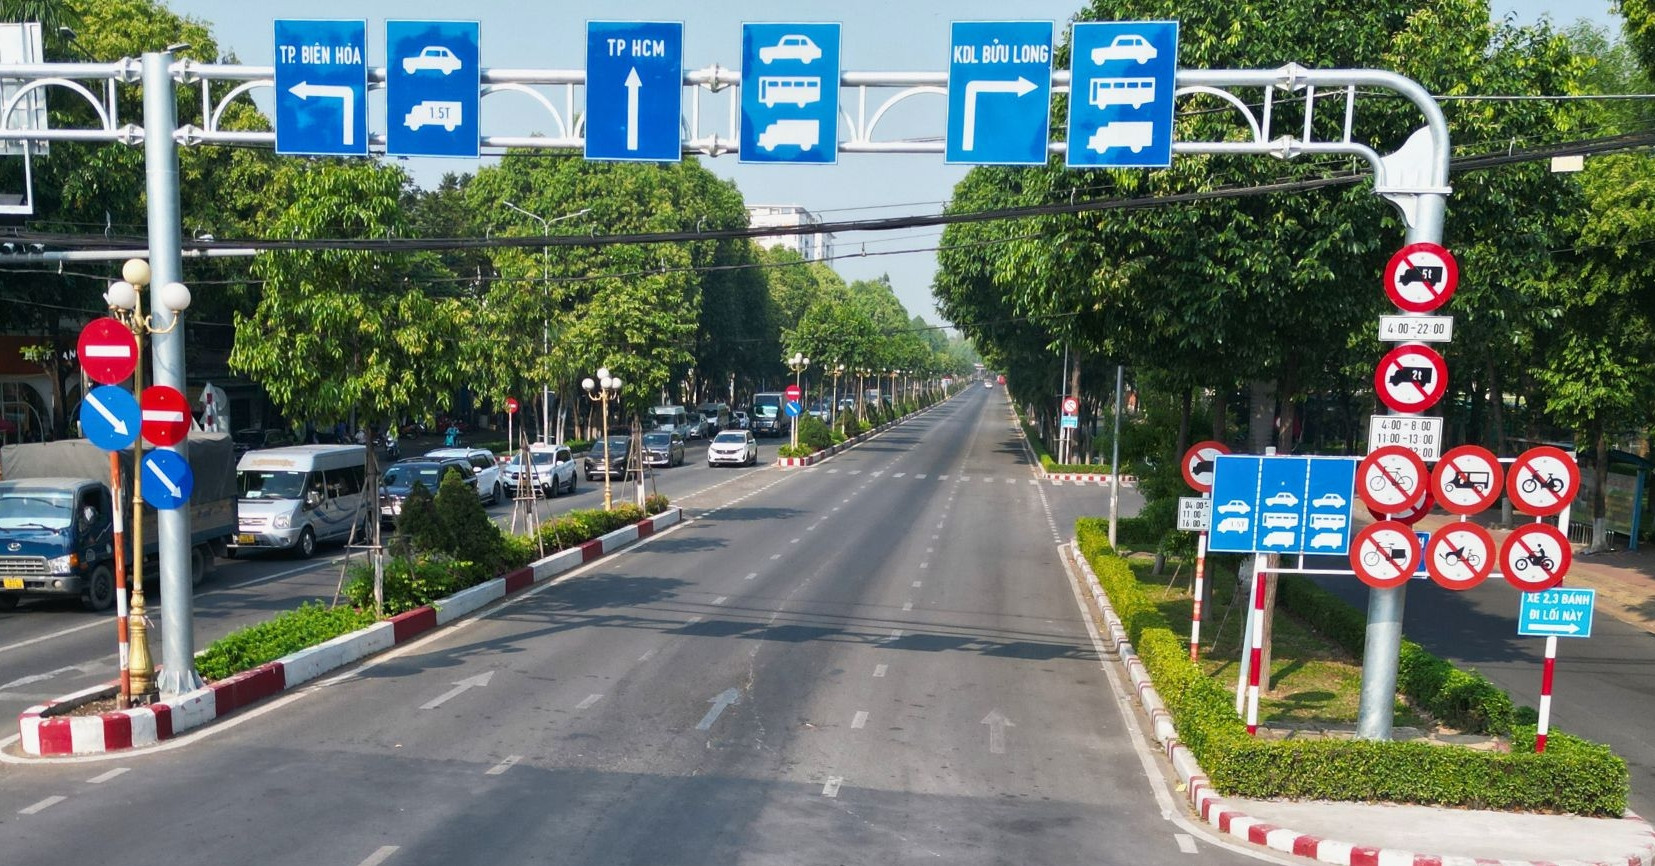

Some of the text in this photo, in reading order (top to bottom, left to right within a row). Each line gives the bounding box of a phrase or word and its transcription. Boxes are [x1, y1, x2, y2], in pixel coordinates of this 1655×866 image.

[279, 45, 296, 64] TP.
[301, 42, 330, 65] BIÊN
[607, 39, 665, 57] TP HCM
[953, 38, 1049, 64] KDL BỬU LONG
[1411, 370, 1423, 381] 2t
[1526, 592, 1541, 604] XE
[1561, 591, 1590, 606] BÁNH
[1529, 608, 1540, 620] ĐI
[1562, 608, 1584, 622] NÀY
